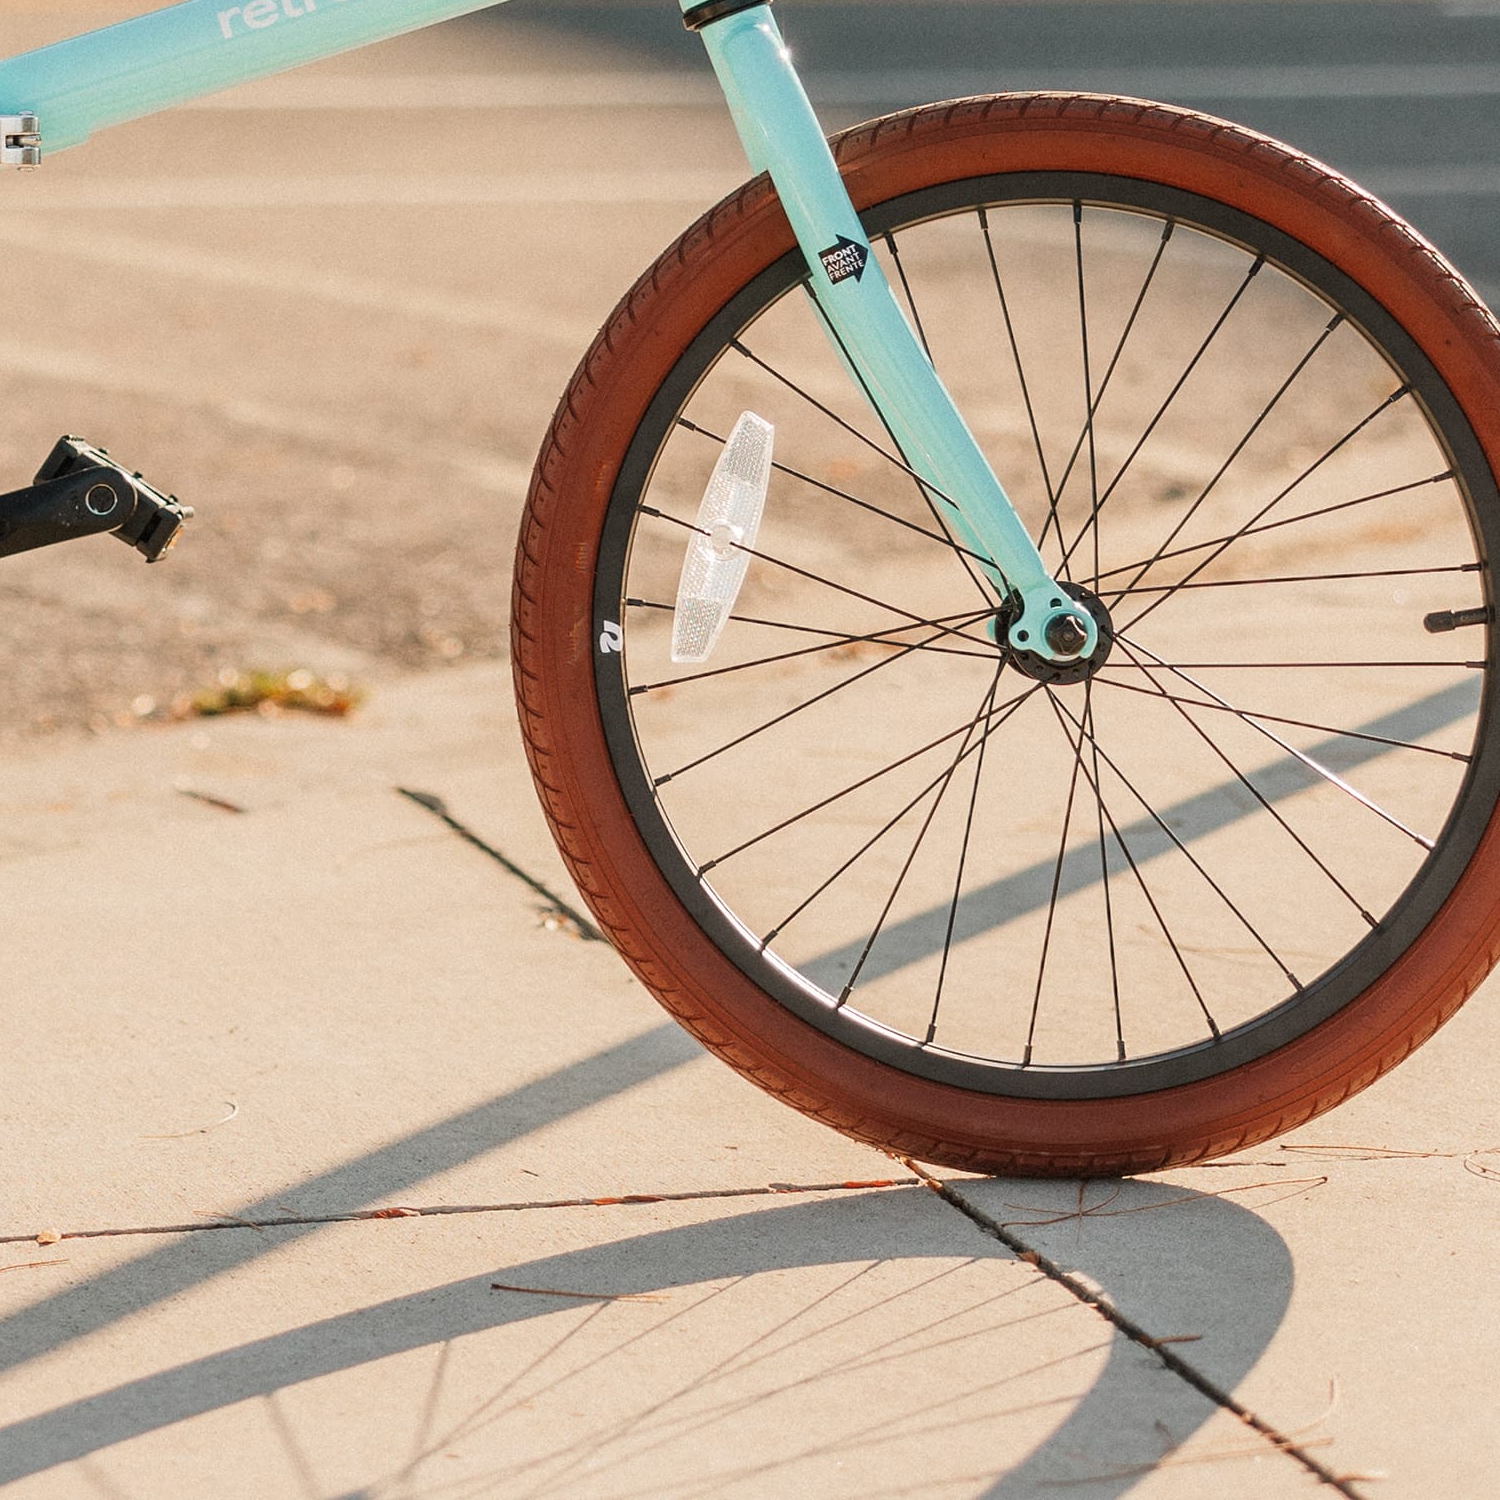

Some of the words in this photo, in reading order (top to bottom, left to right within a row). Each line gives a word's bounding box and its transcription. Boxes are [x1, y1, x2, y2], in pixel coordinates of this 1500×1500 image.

[821, 244, 856, 266] FRONT
[827, 252, 860, 273] AVANT
[829, 259, 865, 280] FRENTE
